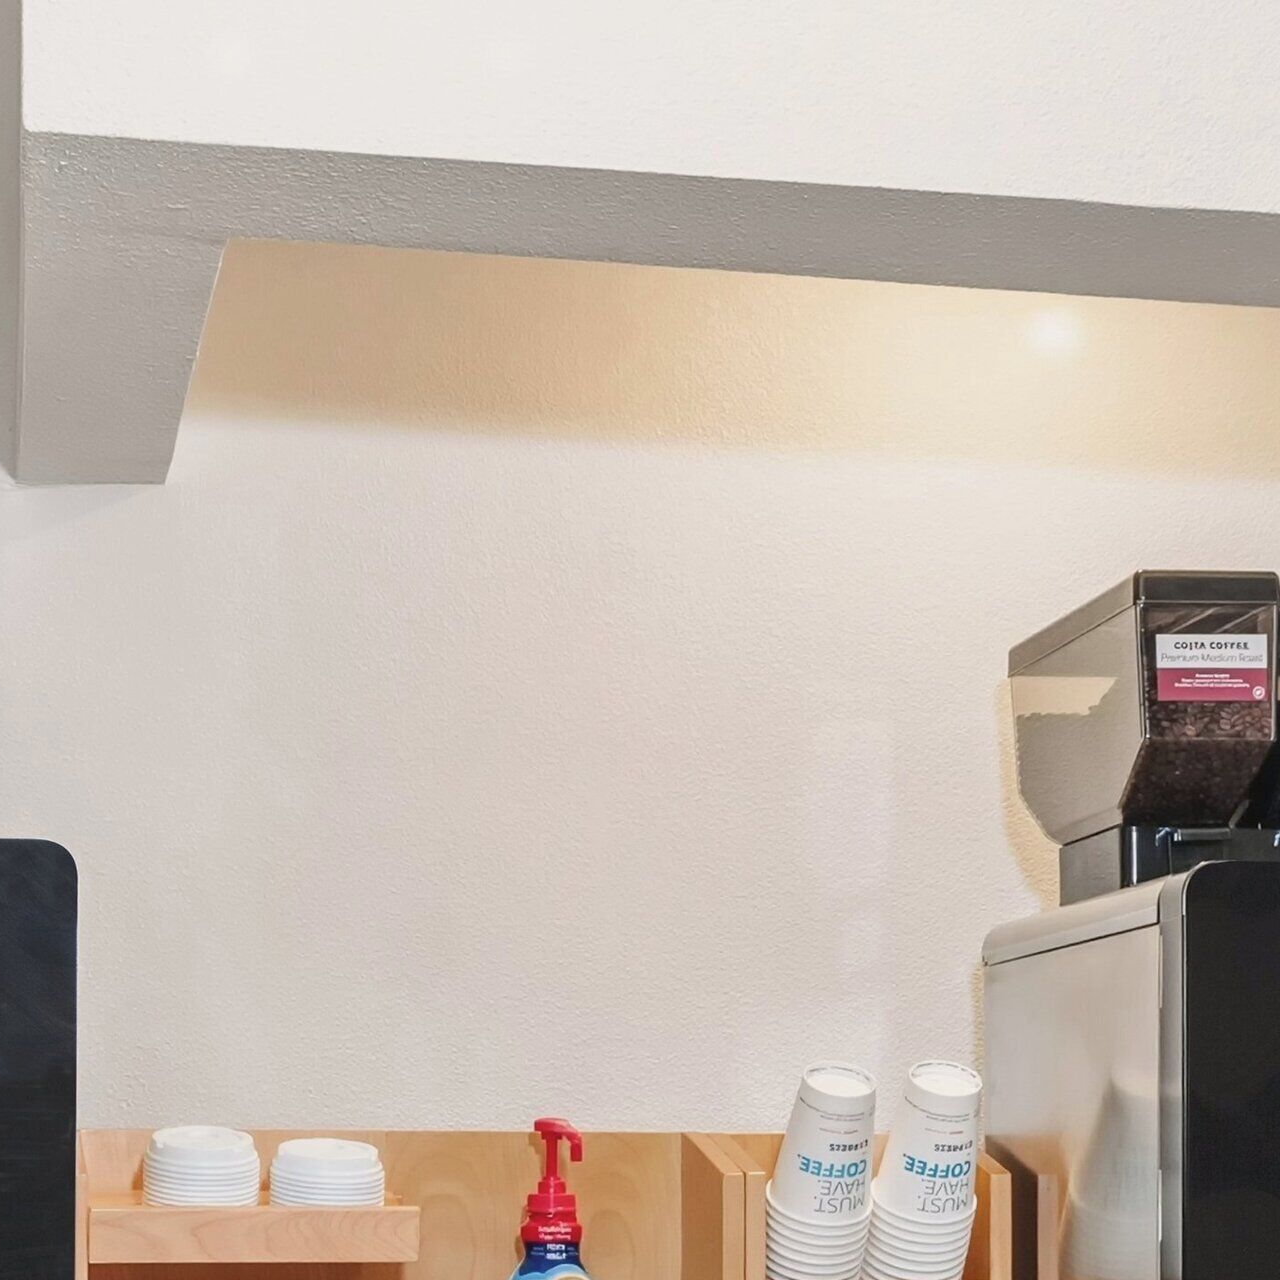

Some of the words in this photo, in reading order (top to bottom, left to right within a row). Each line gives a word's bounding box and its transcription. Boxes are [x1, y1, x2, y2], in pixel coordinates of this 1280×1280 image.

[1174, 641, 1206, 650] COSTA
[1209, 641, 1249, 650] COFFEE
[797, 1154, 867, 1179] COFFEE.
[903, 1153, 971, 1179] COFFEE.
[818, 1178, 865, 1196] HAVE.
[921, 1178, 969, 1196] HAVE.
[814, 1195, 865, 1213] MUST.
[917, 1194, 968, 1213] MUST.
